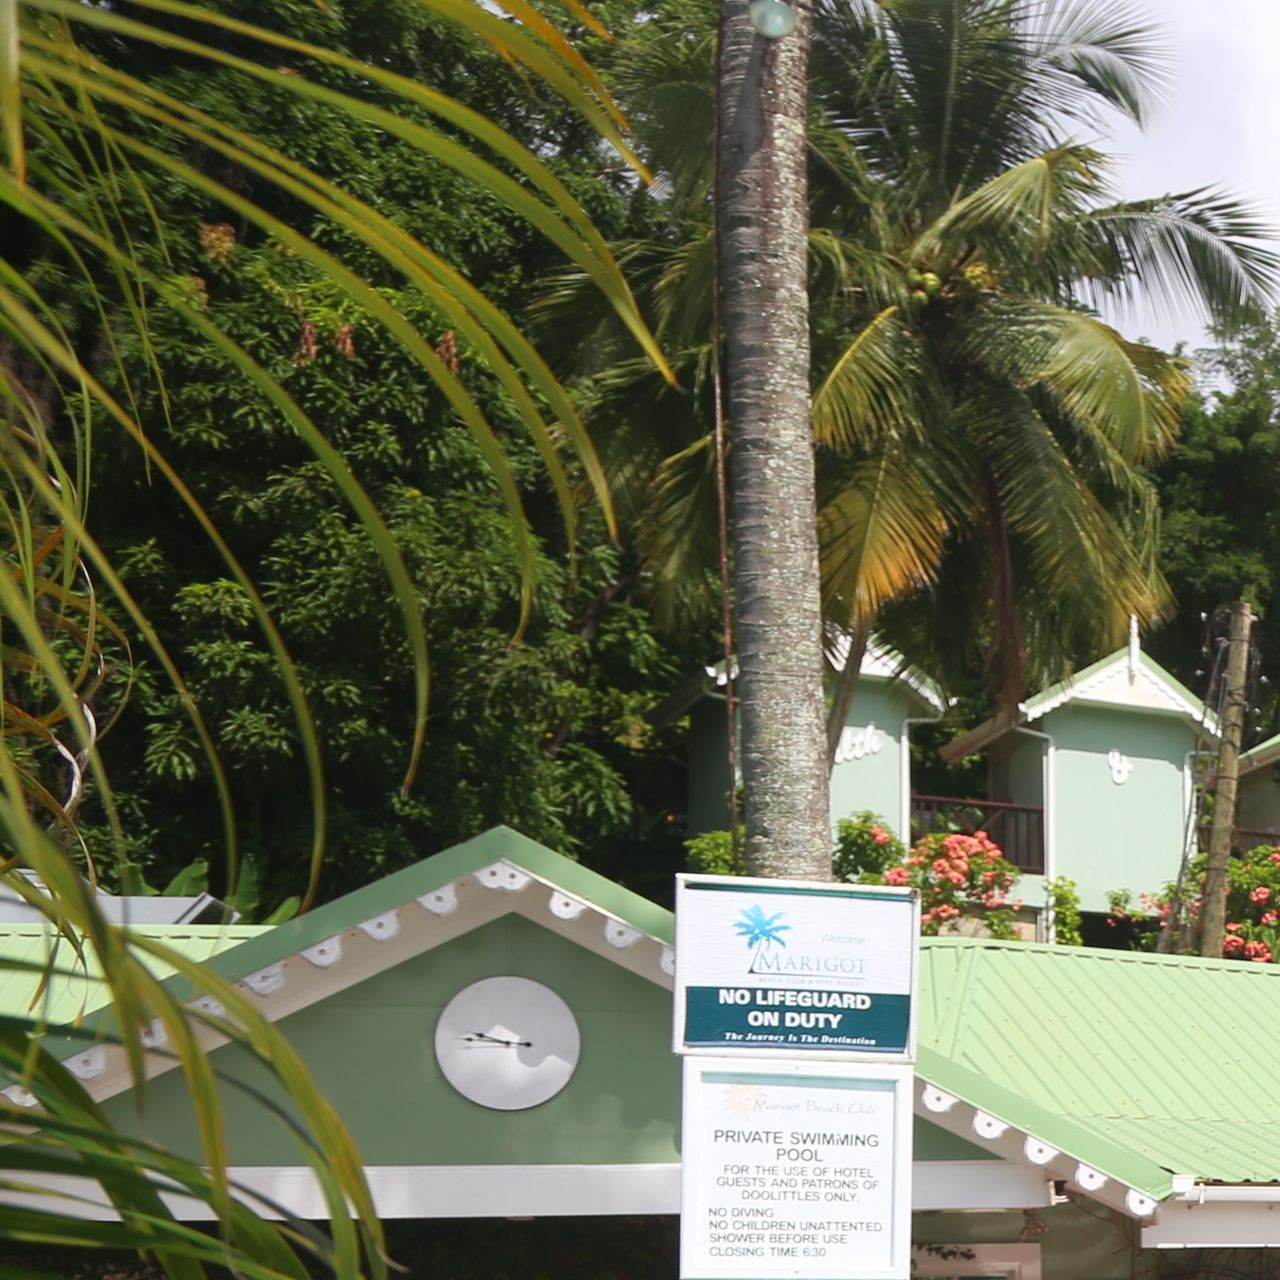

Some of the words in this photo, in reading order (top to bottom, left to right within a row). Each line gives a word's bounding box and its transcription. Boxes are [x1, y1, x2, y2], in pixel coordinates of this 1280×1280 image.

[820, 932, 866, 945] Welcome
[759, 952, 868, 974] MARIGOT
[718, 989, 751, 1005] NO
[755, 990, 872, 1010] LIFEGUARD
[747, 1011, 779, 1027] ON
[784, 1012, 843, 1029] DUTY
[724, 1032, 744, 1041] The
[745, 1033, 785, 1043] Journey
[787, 1033, 798, 1042] Is
[800, 1034, 819, 1043] The
[820, 1035, 877, 1046] Destination
[713, 1129, 784, 1145] PRIVATE
[790, 1131, 879, 1148] SWIMMING
[776, 1148, 824, 1162] POOL
[723, 1164, 749, 1175] FOR
[754, 1165, 779, 1176] THE
[783, 1166, 809, 1177] USE
[812, 1166, 830, 1178] OF
[833, 1167, 874, 1178] HOTEL
[716, 1176, 767, 1188] GUESTS
[770, 1178, 798, 1188] AND
[801, 1178, 859, 1190] PATRONS
[862, 1179, 880, 1190] OF
[741, 1190, 820, 1201] DOOLITTLES
[708, 1207, 728, 1217] NO
[731, 1207, 774, 1218] DIVING
[708, 1220, 729, 1231] NO
[732, 1220, 796, 1231] CHILDREN
[799, 1221, 883, 1232] UNATTENTED
[708, 1232, 765, 1243] SHOWER
[768, 1233, 819, 1244] BEFORE
[822, 1234, 848, 1245] USE
[708, 1246, 765, 1257] CLOSING
[769, 1246, 799, 1258] TIME
